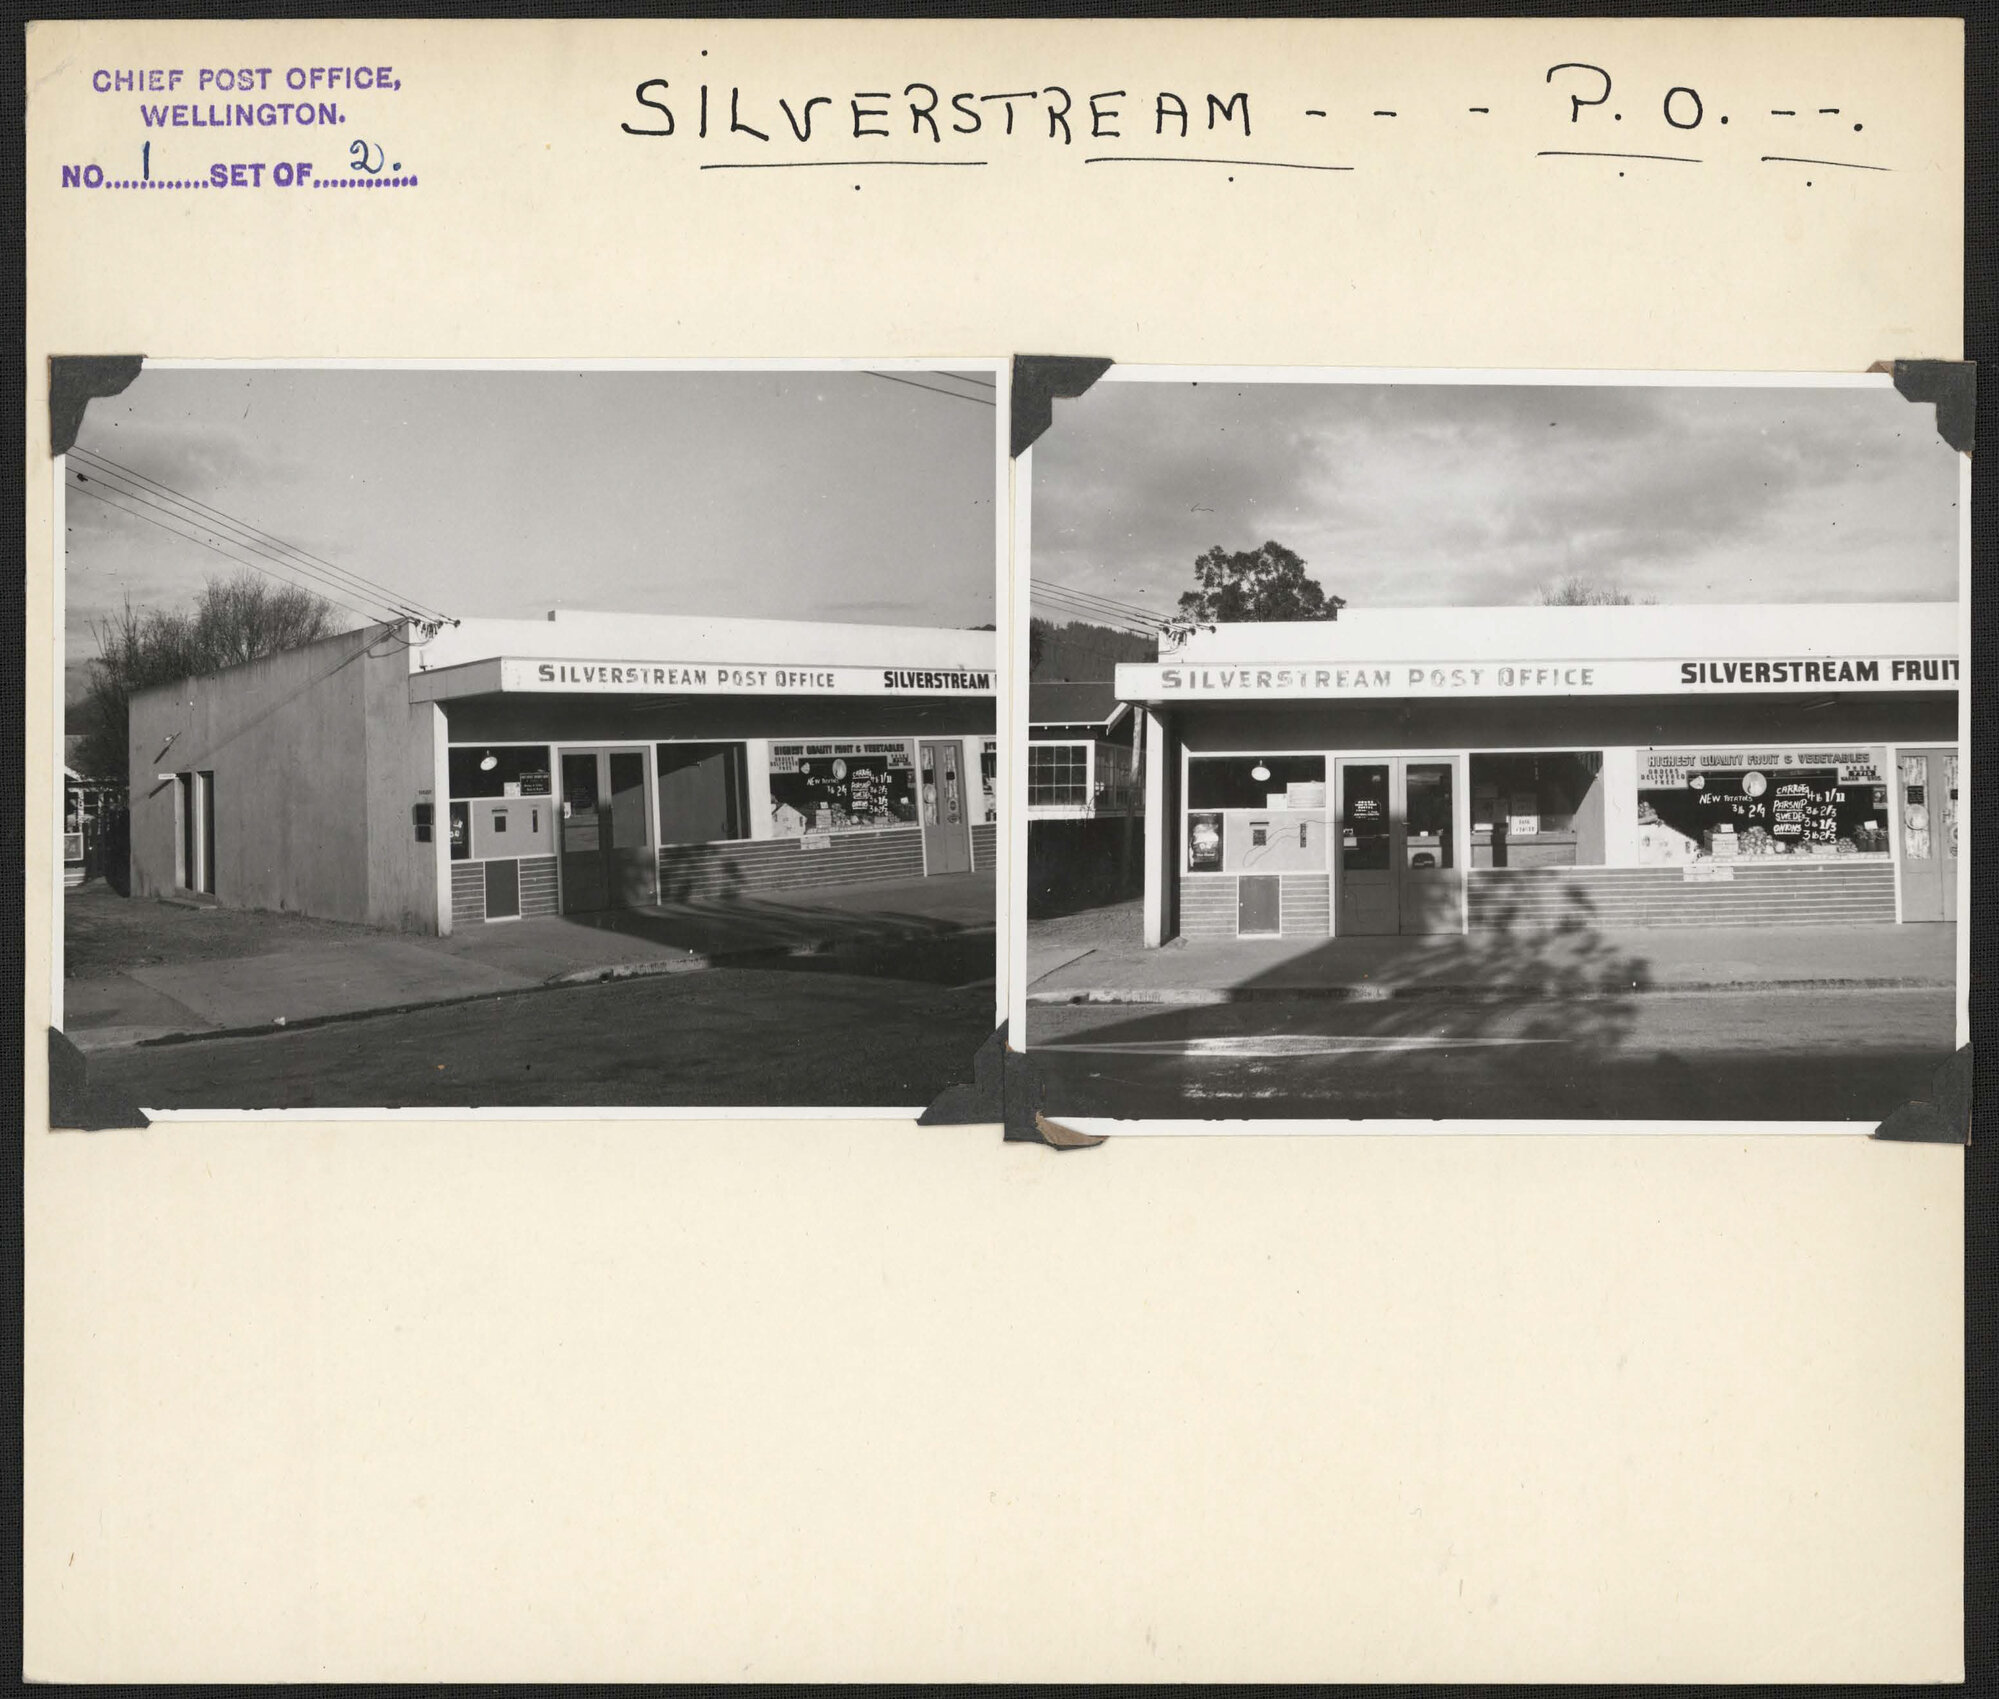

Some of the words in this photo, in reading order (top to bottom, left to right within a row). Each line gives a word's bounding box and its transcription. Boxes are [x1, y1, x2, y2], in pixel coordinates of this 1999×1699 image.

[92, 70, 184, 92] CHIEF
[199, 68, 272, 91] POST
[286, 65, 401, 91] OFFICE,
[621, 52, 1251, 145] SILVERSTREAM
[140, 102, 346, 128] WELLINGTON.
[538, 663, 707, 687] SILVERSTREAM
[717, 669, 768, 688] POST
[775, 671, 836, 689] OFFICE
[883, 671, 990, 690] SILVERSTREAM
[1161, 669, 1392, 689] SILVERSTREAM
[1408, 668, 1484, 689] POST
[1497, 667, 1595, 687] OFFICE
[1681, 660, 1880, 684] SILVERSTREAM
[1648, 756, 1696, 768] HIGHEST
[1701, 755, 1744, 767] QUALITY
[1747, 754, 1780, 765] FRUIT
[1798, 753, 1870, 764] VEGETABLES
[1699, 793, 1721, 804] NEW
[1773, 799, 1807, 812] PARSNIP
[1825, 788, 1846, 803] 1/11
[1773, 824, 1802, 833] ONIONS
